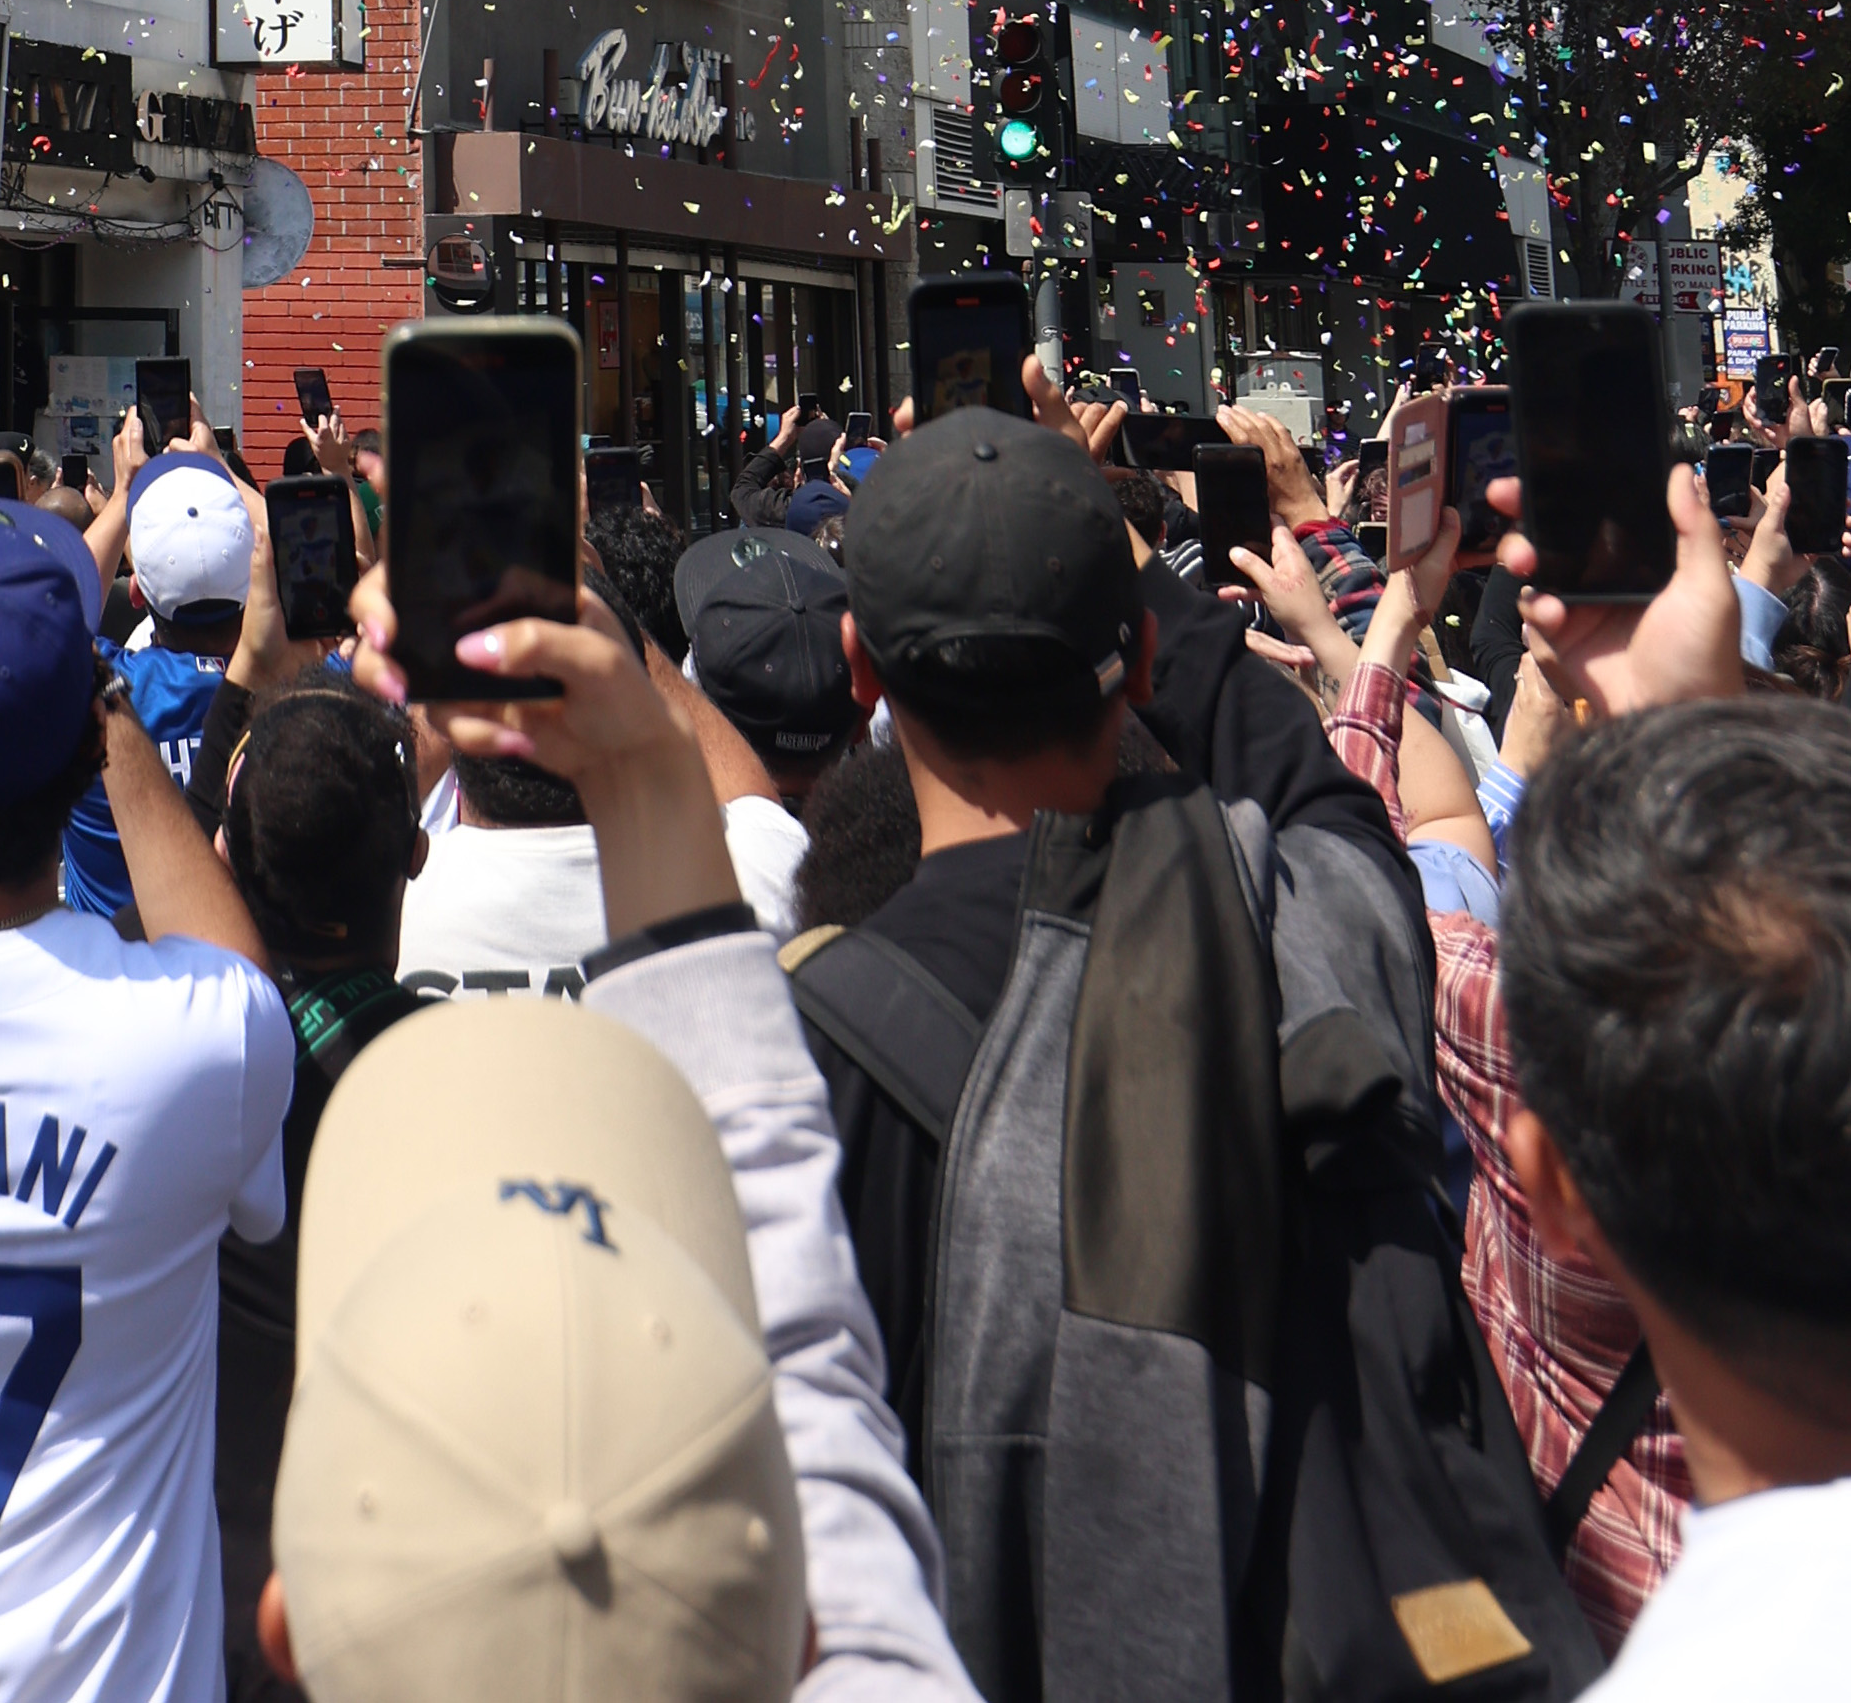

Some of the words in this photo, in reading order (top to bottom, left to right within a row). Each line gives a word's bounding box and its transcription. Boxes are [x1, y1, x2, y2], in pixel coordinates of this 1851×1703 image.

[1652, 263, 1717, 276] PRKING
[1726, 310, 1764, 321] PUBLIC
[1723, 320, 1767, 331] PARKING
